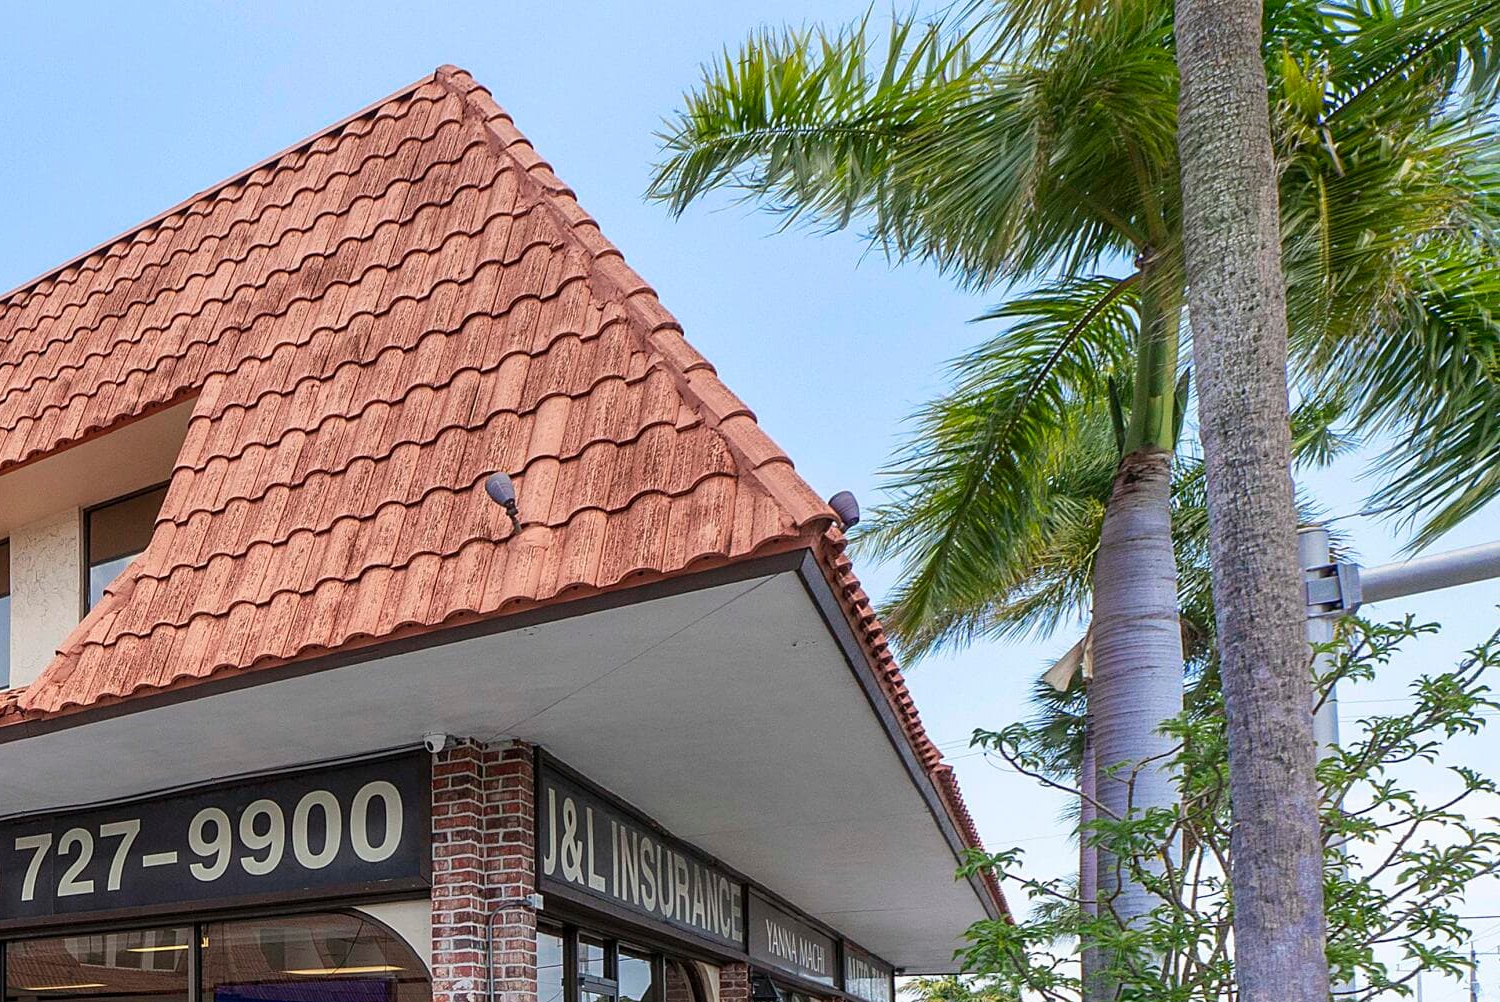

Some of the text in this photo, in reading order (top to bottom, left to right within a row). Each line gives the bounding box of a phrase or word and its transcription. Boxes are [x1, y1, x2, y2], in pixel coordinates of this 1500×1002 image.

[13, 780, 405, 902] 727-9900
[543, 788, 743, 945] J&L INSURANCE
[765, 918, 798, 964] YANNA
